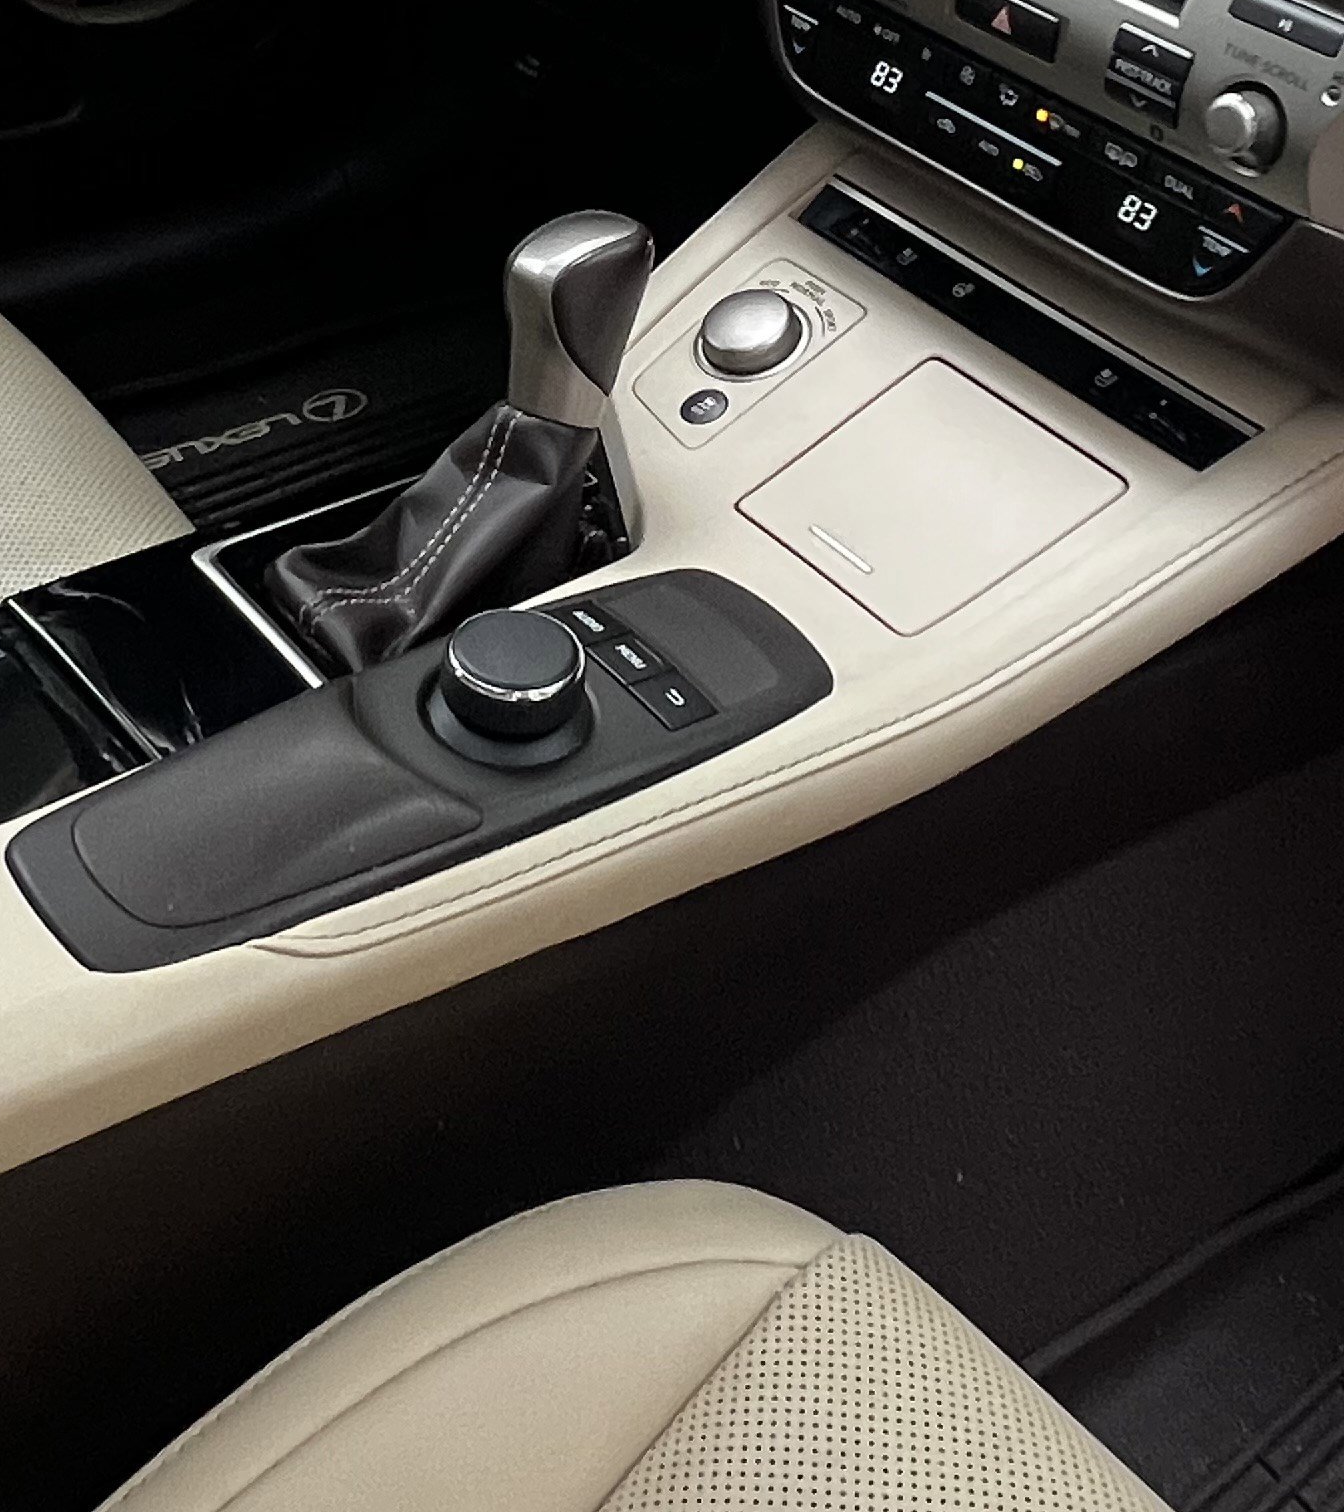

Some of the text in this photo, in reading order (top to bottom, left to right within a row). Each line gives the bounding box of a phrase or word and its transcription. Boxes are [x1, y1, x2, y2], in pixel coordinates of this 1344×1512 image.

[870, 60, 904, 94] 83
[1117, 194, 1157, 232] 83
[140, 411, 303, 470] LEXUS
[614, 643, 647, 670] MENU
